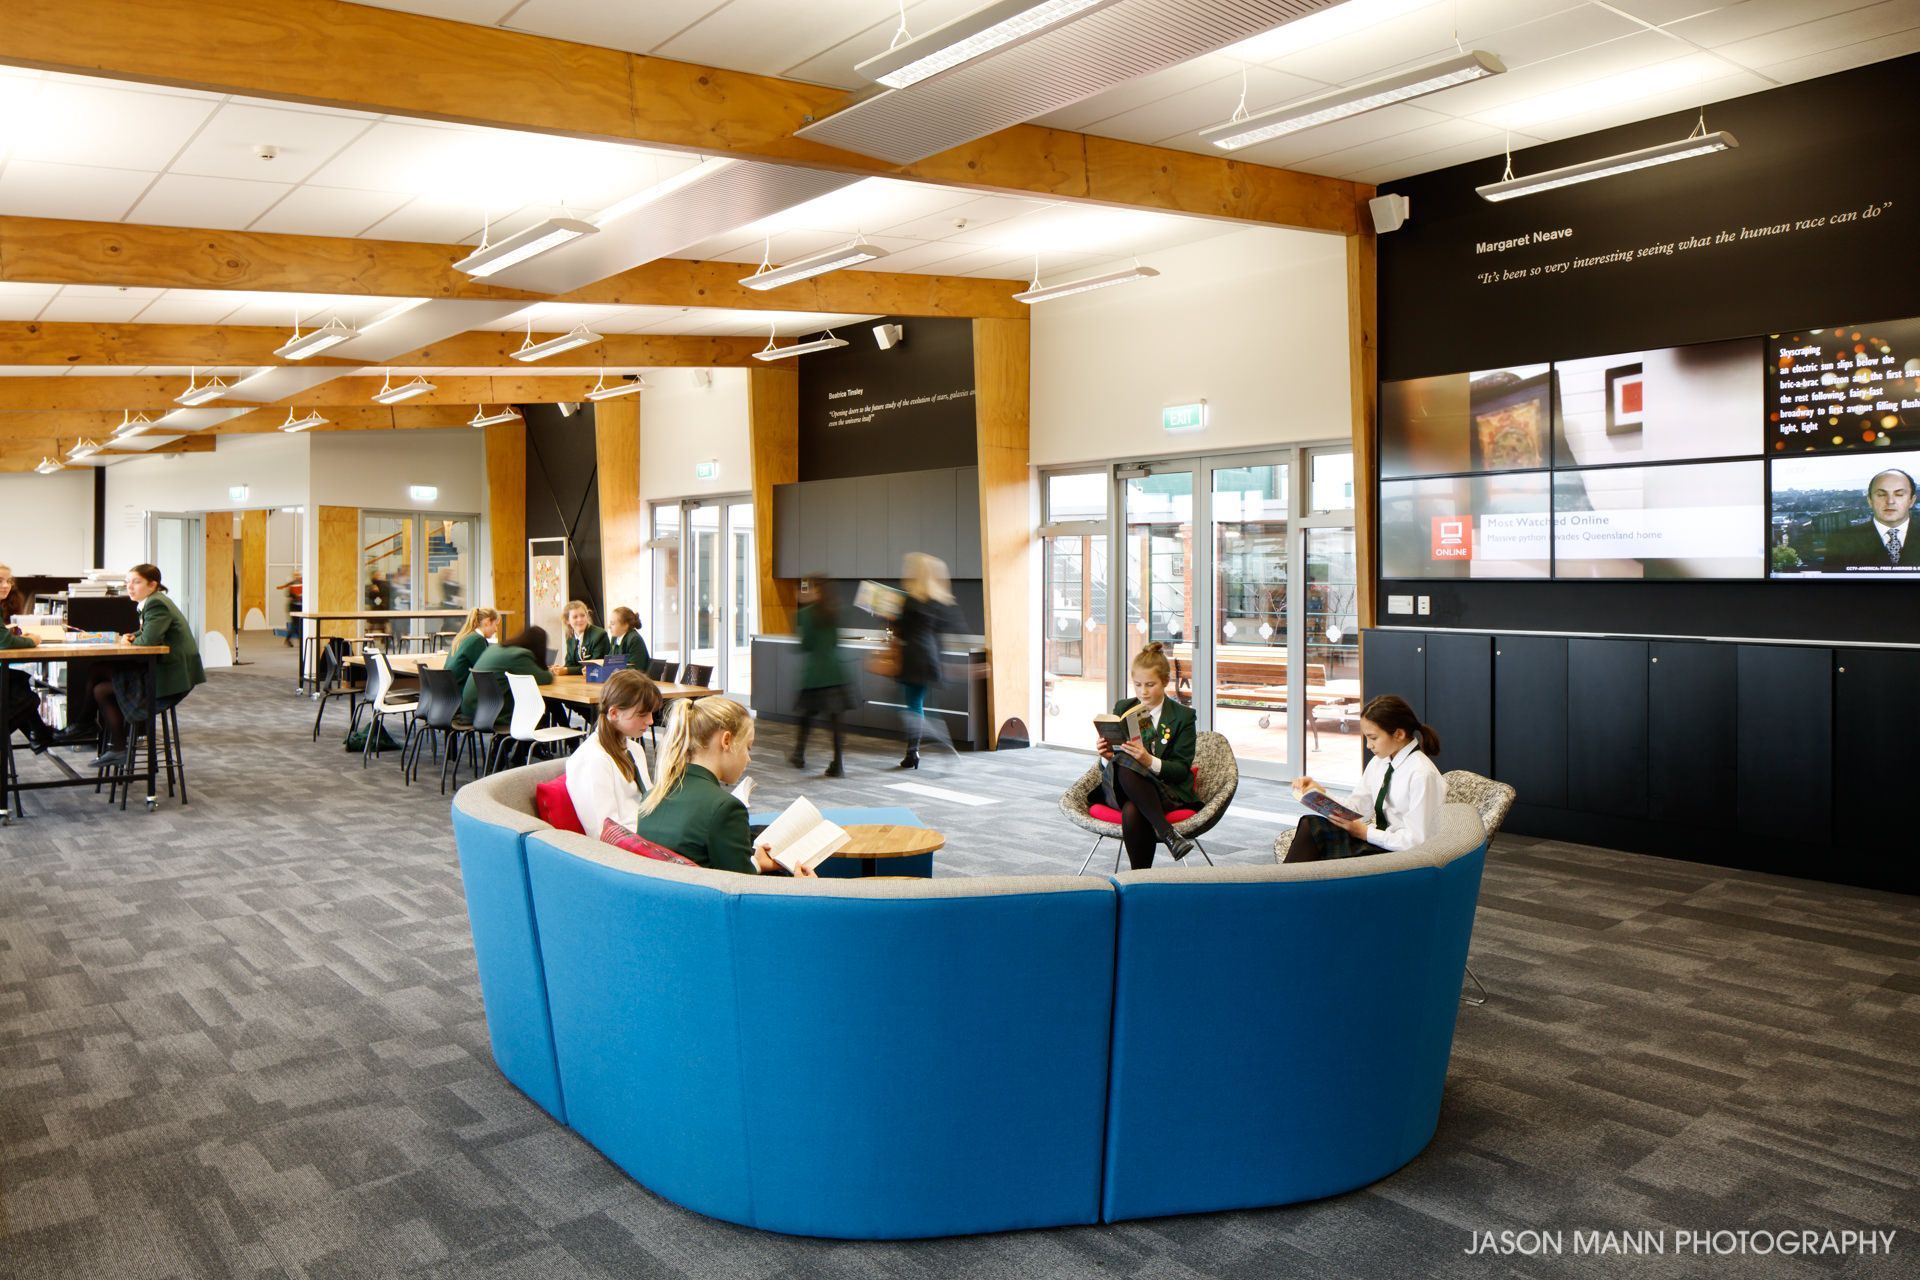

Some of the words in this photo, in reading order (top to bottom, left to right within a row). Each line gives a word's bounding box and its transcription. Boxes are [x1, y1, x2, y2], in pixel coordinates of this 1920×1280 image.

[1476, 234, 1530, 254] Margaret
[1533, 226, 1573, 243] Neave
[1503, 266, 1527, 281] been
[1530, 264, 1542, 276] so
[1545, 259, 1569, 274] very
[1573, 248, 1634, 269] interesting
[1636, 241, 1674, 258] seeing
[1678, 236, 1711, 251] what
[1716, 230, 1736, 244] the
[1739, 222, 1790, 240] human
[1795, 216, 1825, 231] race
[1830, 212, 1857, 226] can
[1780, 345, 1821, 358] Skyscraping
[1792, 363, 1818, 373] electric
[1837, 360, 1853, 370] slips
[1857, 358, 1878, 367] below
[1882, 355, 1895, 364] the
[1780, 379, 1819, 389] bric-a-brac
[1870, 372, 1883, 380] the
[1886, 370, 1902, 379] first
[1780, 394, 1792, 404] the
[1795, 394, 1808, 402] rest
[1850, 388, 1883, 398] fairy-fast
[1780, 409, 1814, 418] broadway
[1829, 405, 1843, 414] first
[1170, 413, 1191, 426] EXIT
[1801, 422, 1818, 433] light
[1488, 518, 1514, 528] Most
[1570, 515, 1610, 525] Online
[1487, 534, 1516, 542] Massive
[1518, 532, 1546, 543] python
[1582, 530, 1634, 541] Queensland
[1636, 530, 1663, 539] home
